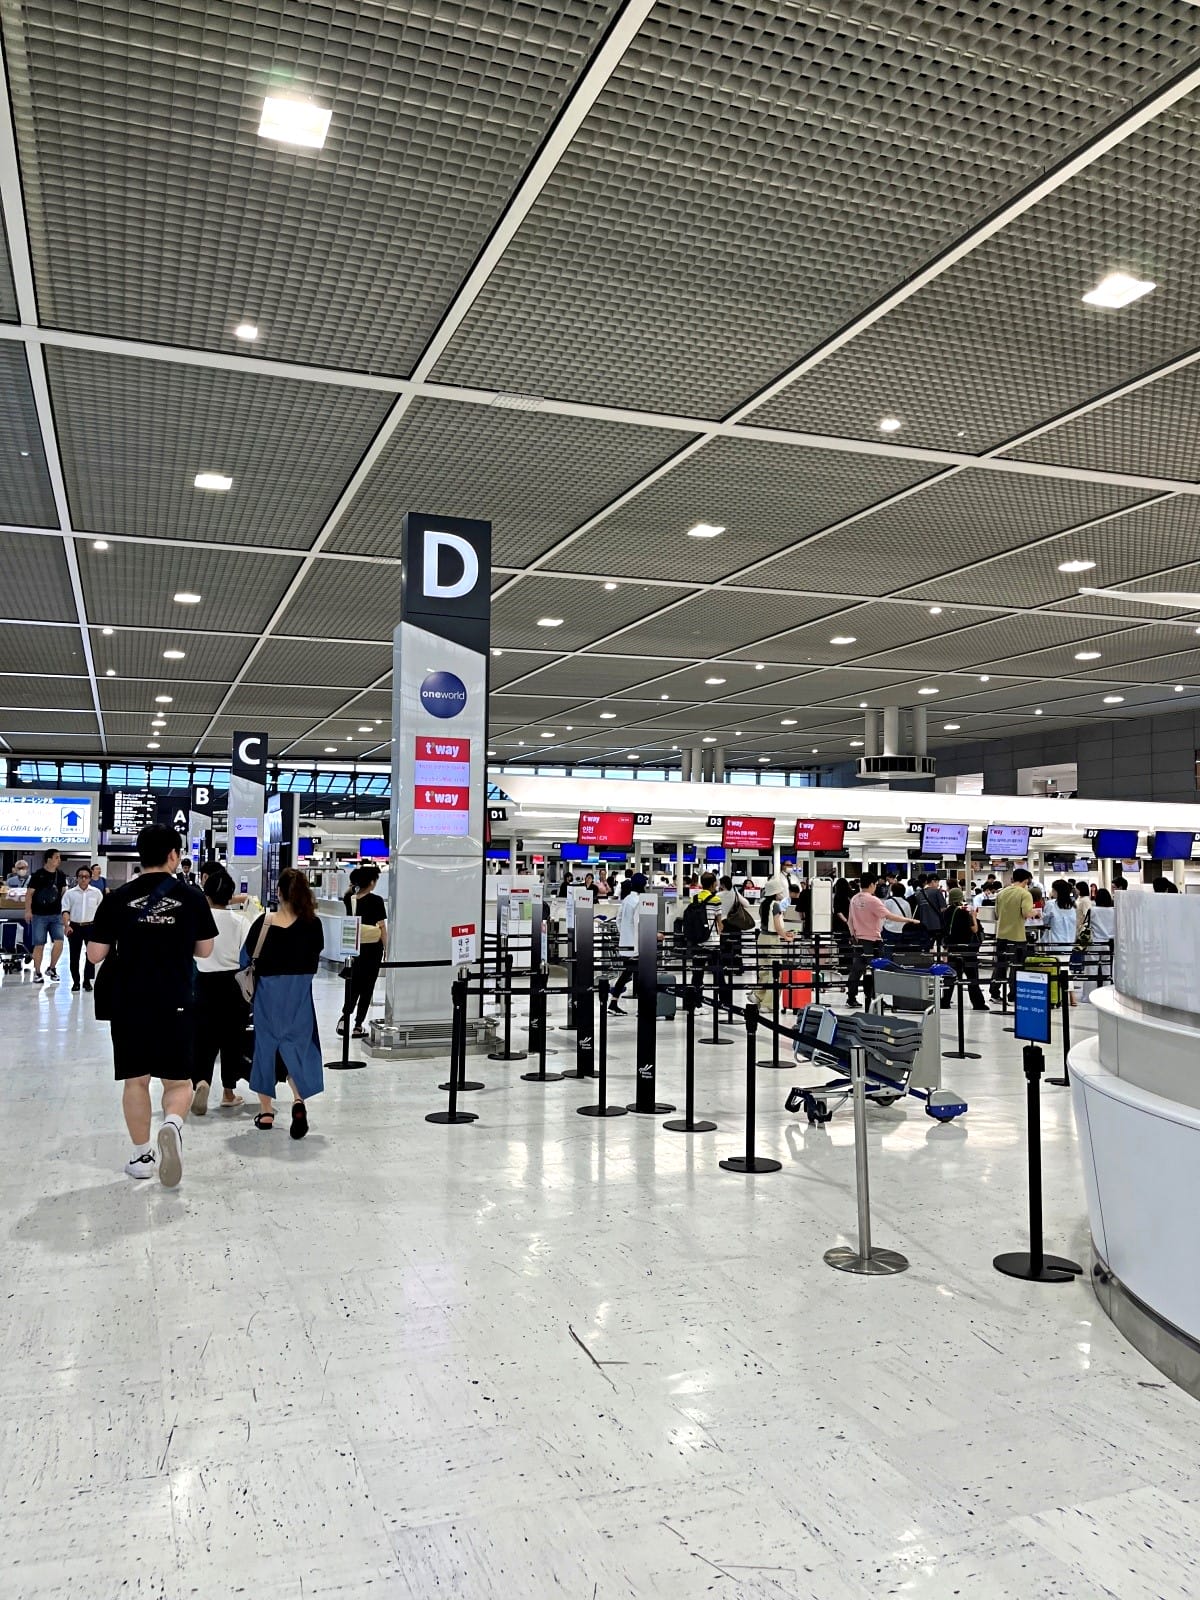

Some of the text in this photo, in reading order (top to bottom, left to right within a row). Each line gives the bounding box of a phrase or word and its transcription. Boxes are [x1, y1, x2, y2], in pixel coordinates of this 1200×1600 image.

[423, 530, 479, 599] D
[422, 691, 465, 700] oneworld
[238, 738, 261, 765] C
[425, 742, 459, 758] t'way
[196, 787, 210, 805] B
[424, 790, 459, 806] t'way
[173, 809, 187, 823] A
[491, 810, 503, 819] D1
[637, 814, 649, 823] D2
[710, 817, 722, 826] D3
[846, 821, 858, 830] D4
[911, 824, 923, 832] D5
[1088, 830, 1098, 838] D7
